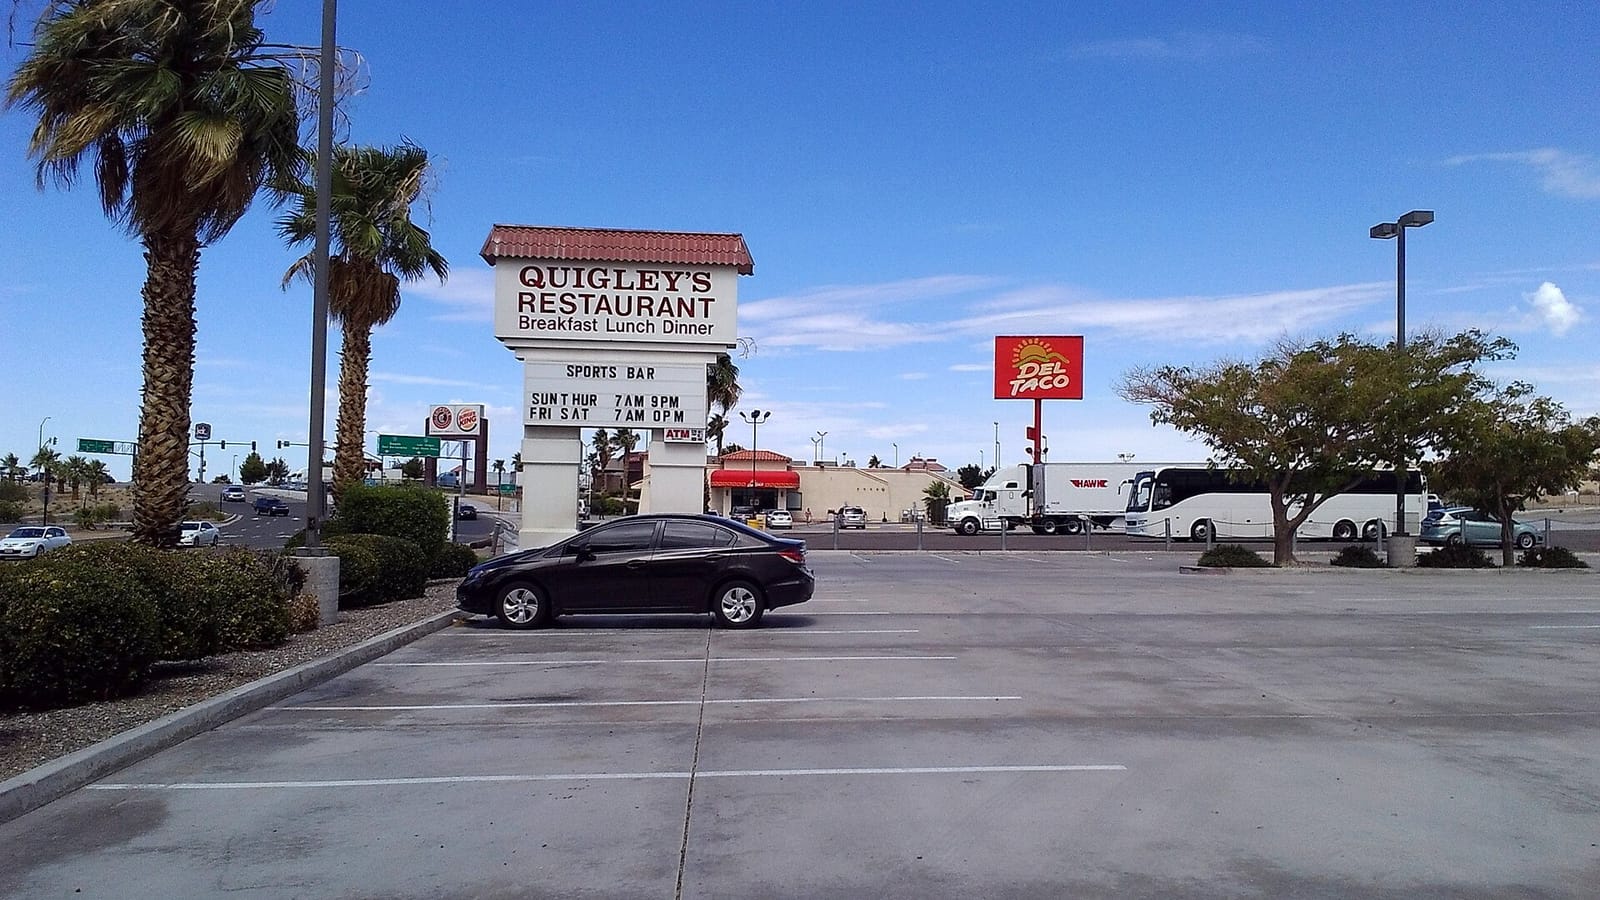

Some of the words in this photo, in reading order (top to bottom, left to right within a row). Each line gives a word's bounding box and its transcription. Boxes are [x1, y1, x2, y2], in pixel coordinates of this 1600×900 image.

[519, 265, 712, 293] QUIGLEY'S
[518, 291, 716, 319] RESTAURANT
[518, 315, 598, 332] Breakfast
[606, 318, 655, 333] Lunch
[662, 319, 715, 335] Dinner
[566, 365, 617, 379] SPORTS
[626, 367, 655, 380] BAR
[1016, 362, 1067, 379] DEL
[1009, 374, 1070, 397] TACO
[615, 394, 645, 408] 7AM
[650, 395, 680, 408] 9PM
[529, 407, 552, 420] FRI
[560, 407, 590, 420] SAT
[614, 409, 646, 422] 7AM
[665, 429, 690, 439] ATM
[1069, 479, 1109, 488] HAWK
